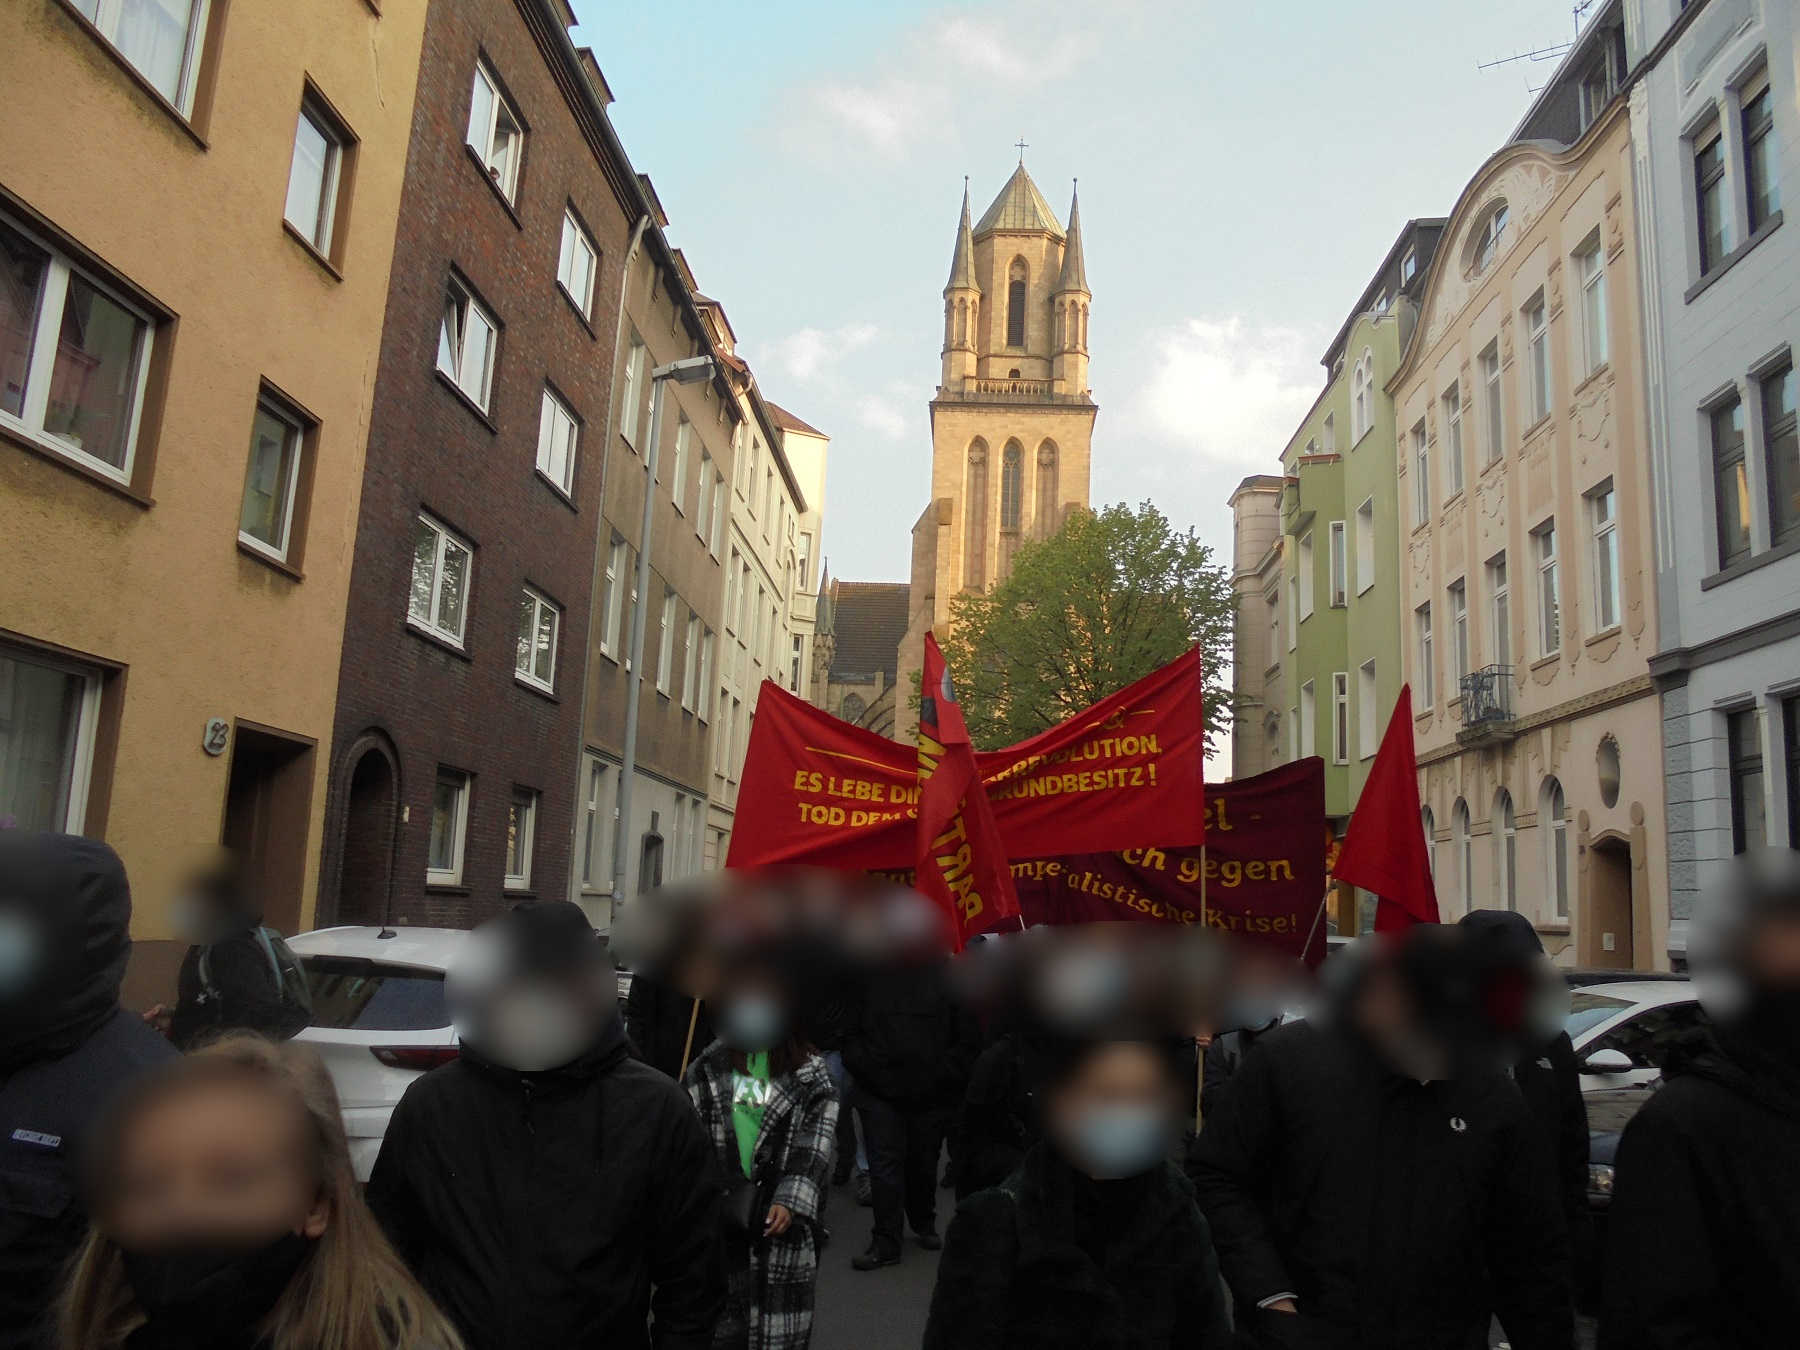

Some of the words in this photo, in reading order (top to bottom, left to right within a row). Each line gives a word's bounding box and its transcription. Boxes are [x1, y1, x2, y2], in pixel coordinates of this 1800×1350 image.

[208, 722, 229, 749] 23
[794, 770, 823, 793] ES
[828, 777, 885, 803] LEBE
[798, 802, 845, 826] TOD
[1176, 857, 1295, 888] gegen
[1205, 909, 1298, 933] Krise!
